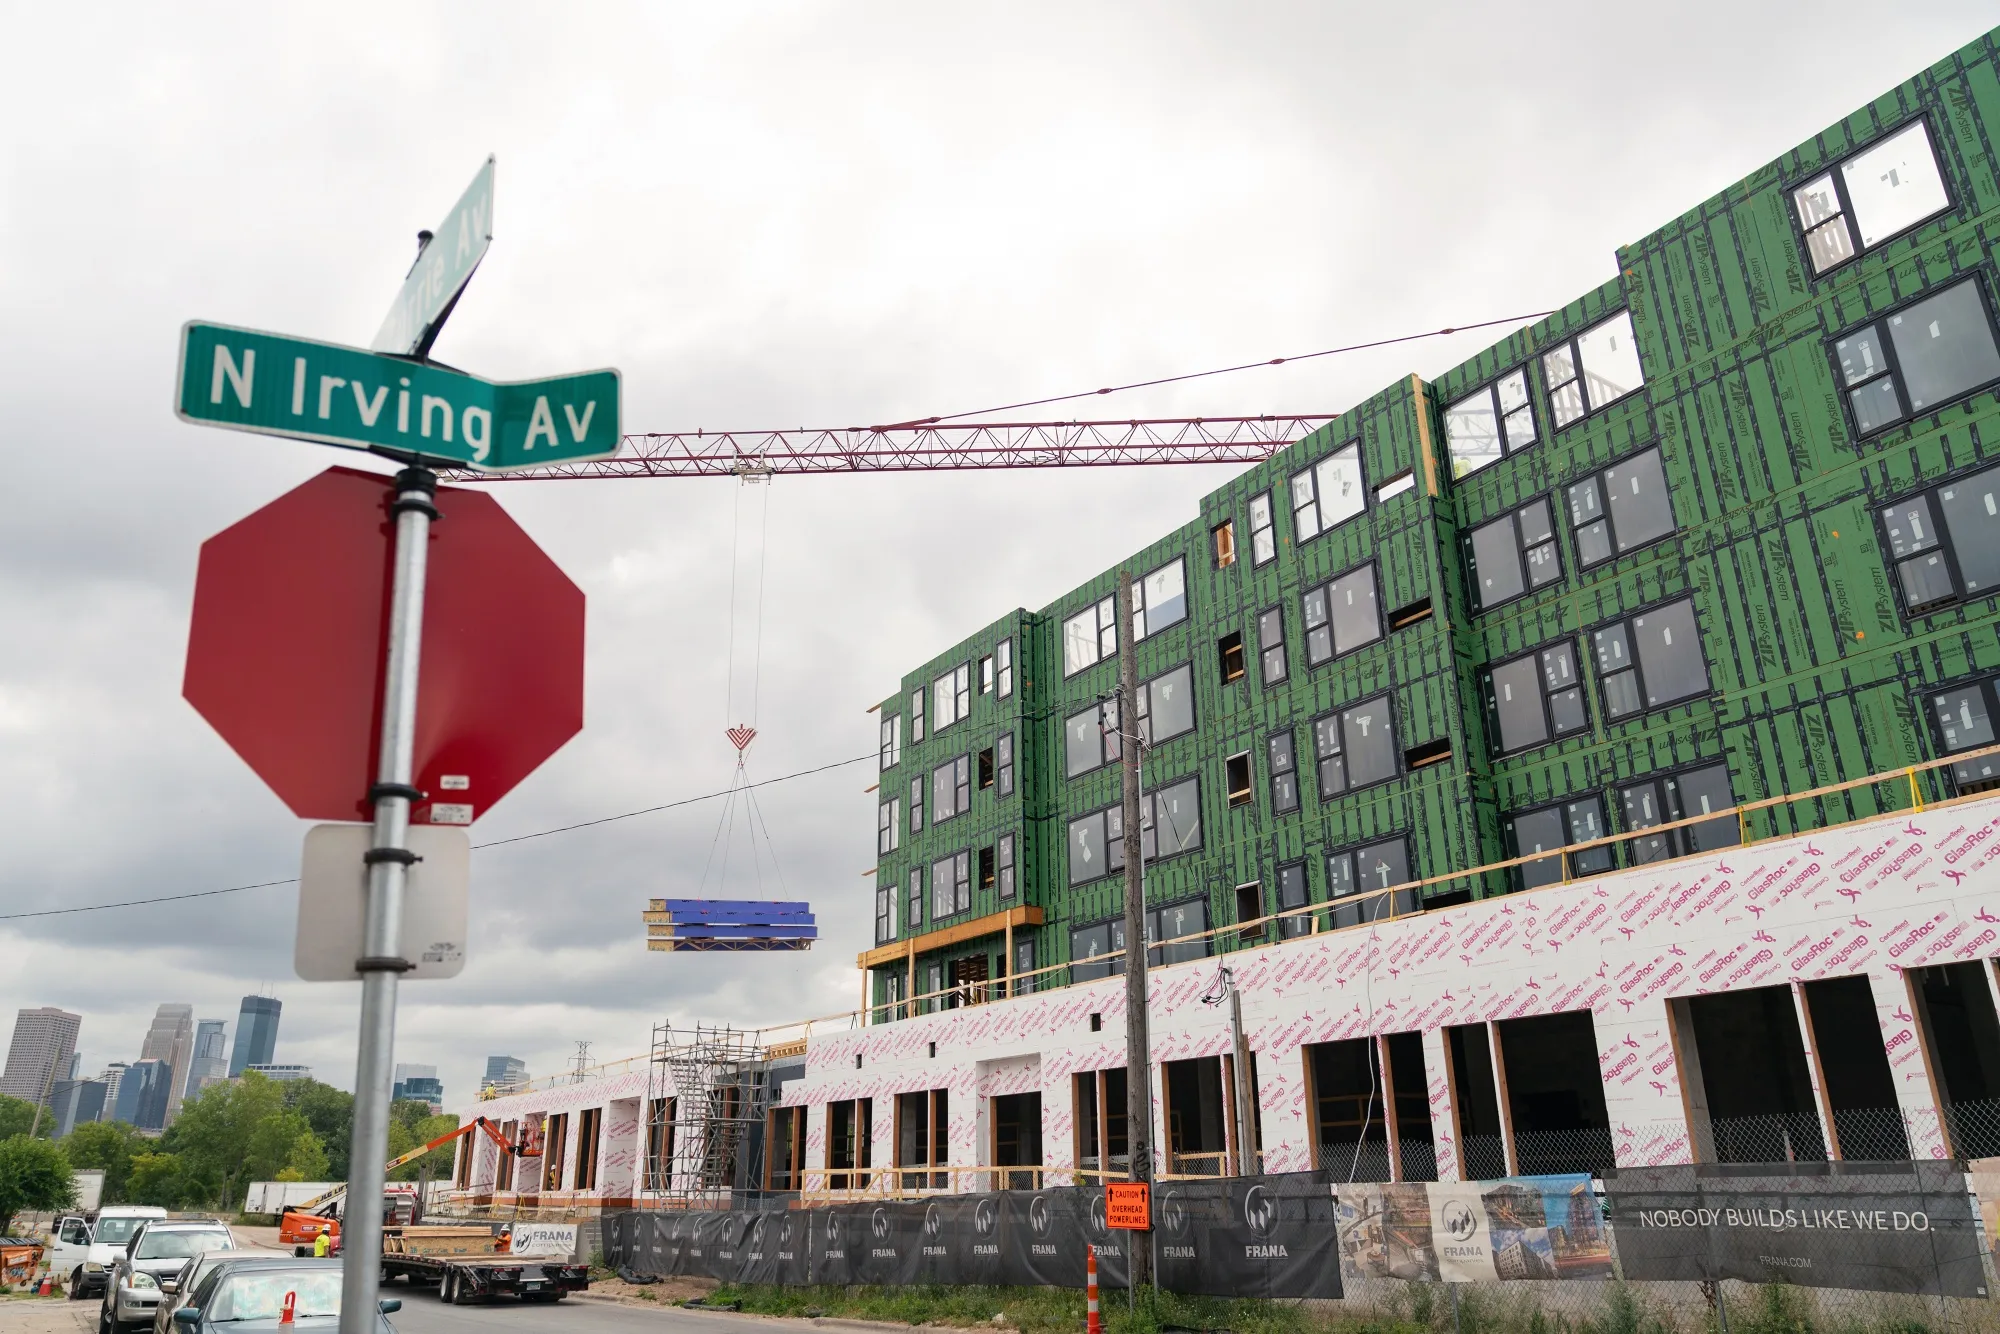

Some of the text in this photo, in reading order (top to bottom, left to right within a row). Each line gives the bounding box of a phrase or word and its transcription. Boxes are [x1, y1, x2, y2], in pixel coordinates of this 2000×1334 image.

[455, 193, 486, 271] Av
[210, 344, 596, 462] N Irving Av
[1934, 825, 1967, 850] CertainTeed
[1944, 826, 1993, 864] GlasRoc
[1878, 843, 1923, 879] GlasRoc
[1748, 865, 1788, 900] GlasRoc
[1780, 863, 1820, 897] GlasRoc
[1620, 892, 1655, 923] GlasRoc
[1671, 883, 1701, 911] lasRoc
[1693, 880, 1731, 913] GlasRoc
[1549, 906, 1581, 935] GlasRoc
[1574, 903, 1607, 933] GlasRoc
[1462, 922, 1490, 949] GlasRoc
[1484, 920, 1512, 948] GlasRoc
[1879, 920, 1909, 943] CertainTeed
[1888, 922, 1935, 958] GlasRoc
[1927, 927, 1961, 956] asRoc
[1337, 948, 1361, 974] GlasRoc
[1791, 937, 1833, 971] GlasRoc
[1825, 935, 1868, 969] GlasRoc
[1276, 958, 1297, 982] GlasRoc
[1620, 963, 1654, 993] GlasRoc
[1648, 962, 1683, 993] GlasRoc
[1699, 951, 1737, 984] GlasRoc
[1485, 995, 1514, 1021] GlasRoc
[1508, 994, 1538, 1019] GlasRo
[1551, 985, 1584, 1013] GlasRoc
[1320, 1019, 1344, 1042] GlasRoc
[1406, 1006, 1432, 1031] GlasRoc
[1272, 1025, 1294, 1049] GlasRoc
[1886, 1029, 1913, 1056] Glas
[1603, 1053, 1637, 1082] GlasRoc
[1429, 1084, 1449, 1105] GlasR
[1615, 1143, 1632, 1159] Glas
[1648, 1137, 1684, 1167] GlasRoc
[320, 1191, 333, 1201] JLG
[1110, 1216, 1145, 1224] POWERLINES
[1640, 1208, 1935, 1231] NOBODY BUILDS LIKE WE DO.
[533, 1231, 572, 1241] FRANA
[872, 1249, 896, 1258] FRANA
[923, 1246, 947, 1256] FRANA
[974, 1244, 999, 1255] FRANA
[1032, 1244, 1057, 1255] FRANA
[1092, 1246, 1121, 1257] FRANA
[1164, 1246, 1196, 1258] FRANA
[1245, 1244, 1288, 1257] FRANA
[1443, 1246, 1482, 1257] FRANA
[1759, 1255, 1812, 1268] FRANA.COM
